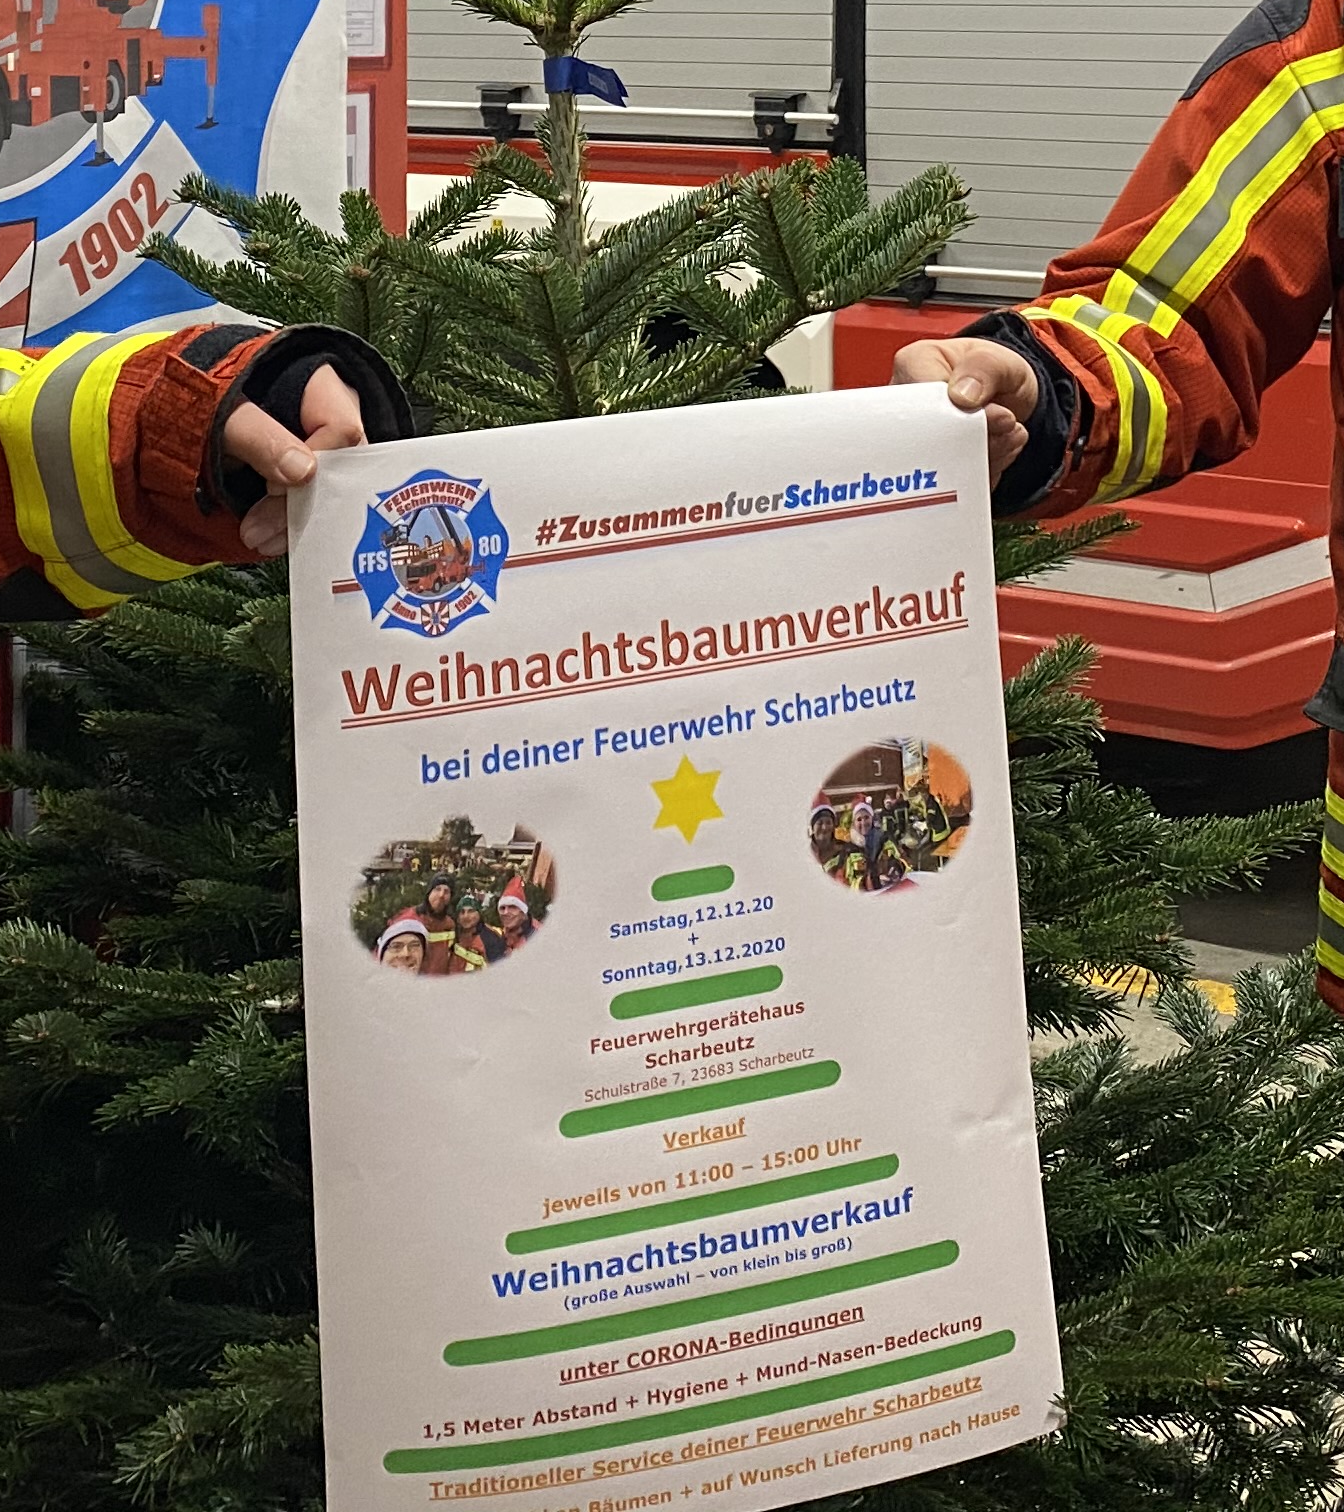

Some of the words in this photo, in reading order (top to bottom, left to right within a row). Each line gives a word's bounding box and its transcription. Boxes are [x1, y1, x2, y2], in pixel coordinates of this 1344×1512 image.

[59, 172, 171, 296] 1902
[383, 481, 477, 513] FEUERWEHR
[396, 494, 466, 516] Scharbeutz
[535, 469, 938, 546] #ZusammenfuerScharbeutz
[358, 551, 389, 574] FFS
[478, 535, 502, 557] 80
[392, 601, 417, 620] Anno
[454, 590, 478, 613] 1902
[341, 571, 966, 716] Weihnachtsbaumverkauf
[420, 751, 471, 785] bei
[482, 736, 584, 775] deiner
[594, 706, 756, 757] Feuerwehr
[764, 677, 916, 728] Scharbeutz
[609, 895, 774, 939] Samstag,12.12.20
[687, 933, 699, 945] +
[602, 937, 785, 984] Sonntag,13.12.2020
[590, 1000, 805, 1054] Feuerwehrgerätehaus
[645, 1035, 755, 1069] Scharbeutz
[584, 1075, 667, 1103] Schulstraße
[673, 1073, 685, 1087] 7,
[691, 1061, 734, 1082] 23683
[738, 1047, 815, 1072] Scharbeutz
[663, 1117, 746, 1150] Verkauf
[542, 1185, 621, 1219] jeweils
[627, 1178, 667, 1200] von
[675, 1161, 735, 1190] 11:00
[761, 1142, 820, 1171] 15:00
[826, 1135, 863, 1159] Uhr
[491, 1187, 914, 1299] Weihnachtsbaumverkauf
[563, 1288, 619, 1311] (große
[623, 1270, 690, 1297] Auswahl
[710, 1264, 738, 1279] von
[743, 1253, 780, 1272] klein
[785, 1246, 807, 1263] bis
[811, 1236, 853, 1260] groß)
[559, 1359, 620, 1383] unter
[627, 1305, 864, 1370] CORONA-Bedingungen
[423, 1422, 456, 1441] 1,5
[464, 1415, 525, 1435] Meter
[532, 1397, 617, 1426] Abstand
[626, 1395, 640, 1410] +
[647, 1375, 729, 1407] Hygiene
[735, 1372, 749, 1387] +
[756, 1314, 983, 1383] Mund-Nasen-Bedeckung
[429, 1464, 586, 1499] Traditioneller
[592, 1444, 674, 1477] Service
[679, 1432, 749, 1460] deiner
[756, 1406, 866, 1443] Feuerwehr
[872, 1375, 983, 1417] Scharbeutz
[588, 1489, 672, 1512] Bäumen
[680, 1484, 694, 1499] +
[701, 1474, 733, 1496] auf
[740, 1457, 816, 1485] Wunsch
[823, 1433, 912, 1468] Lieferung
[919, 1420, 961, 1444] nach
[968, 1403, 1021, 1431] Hause
